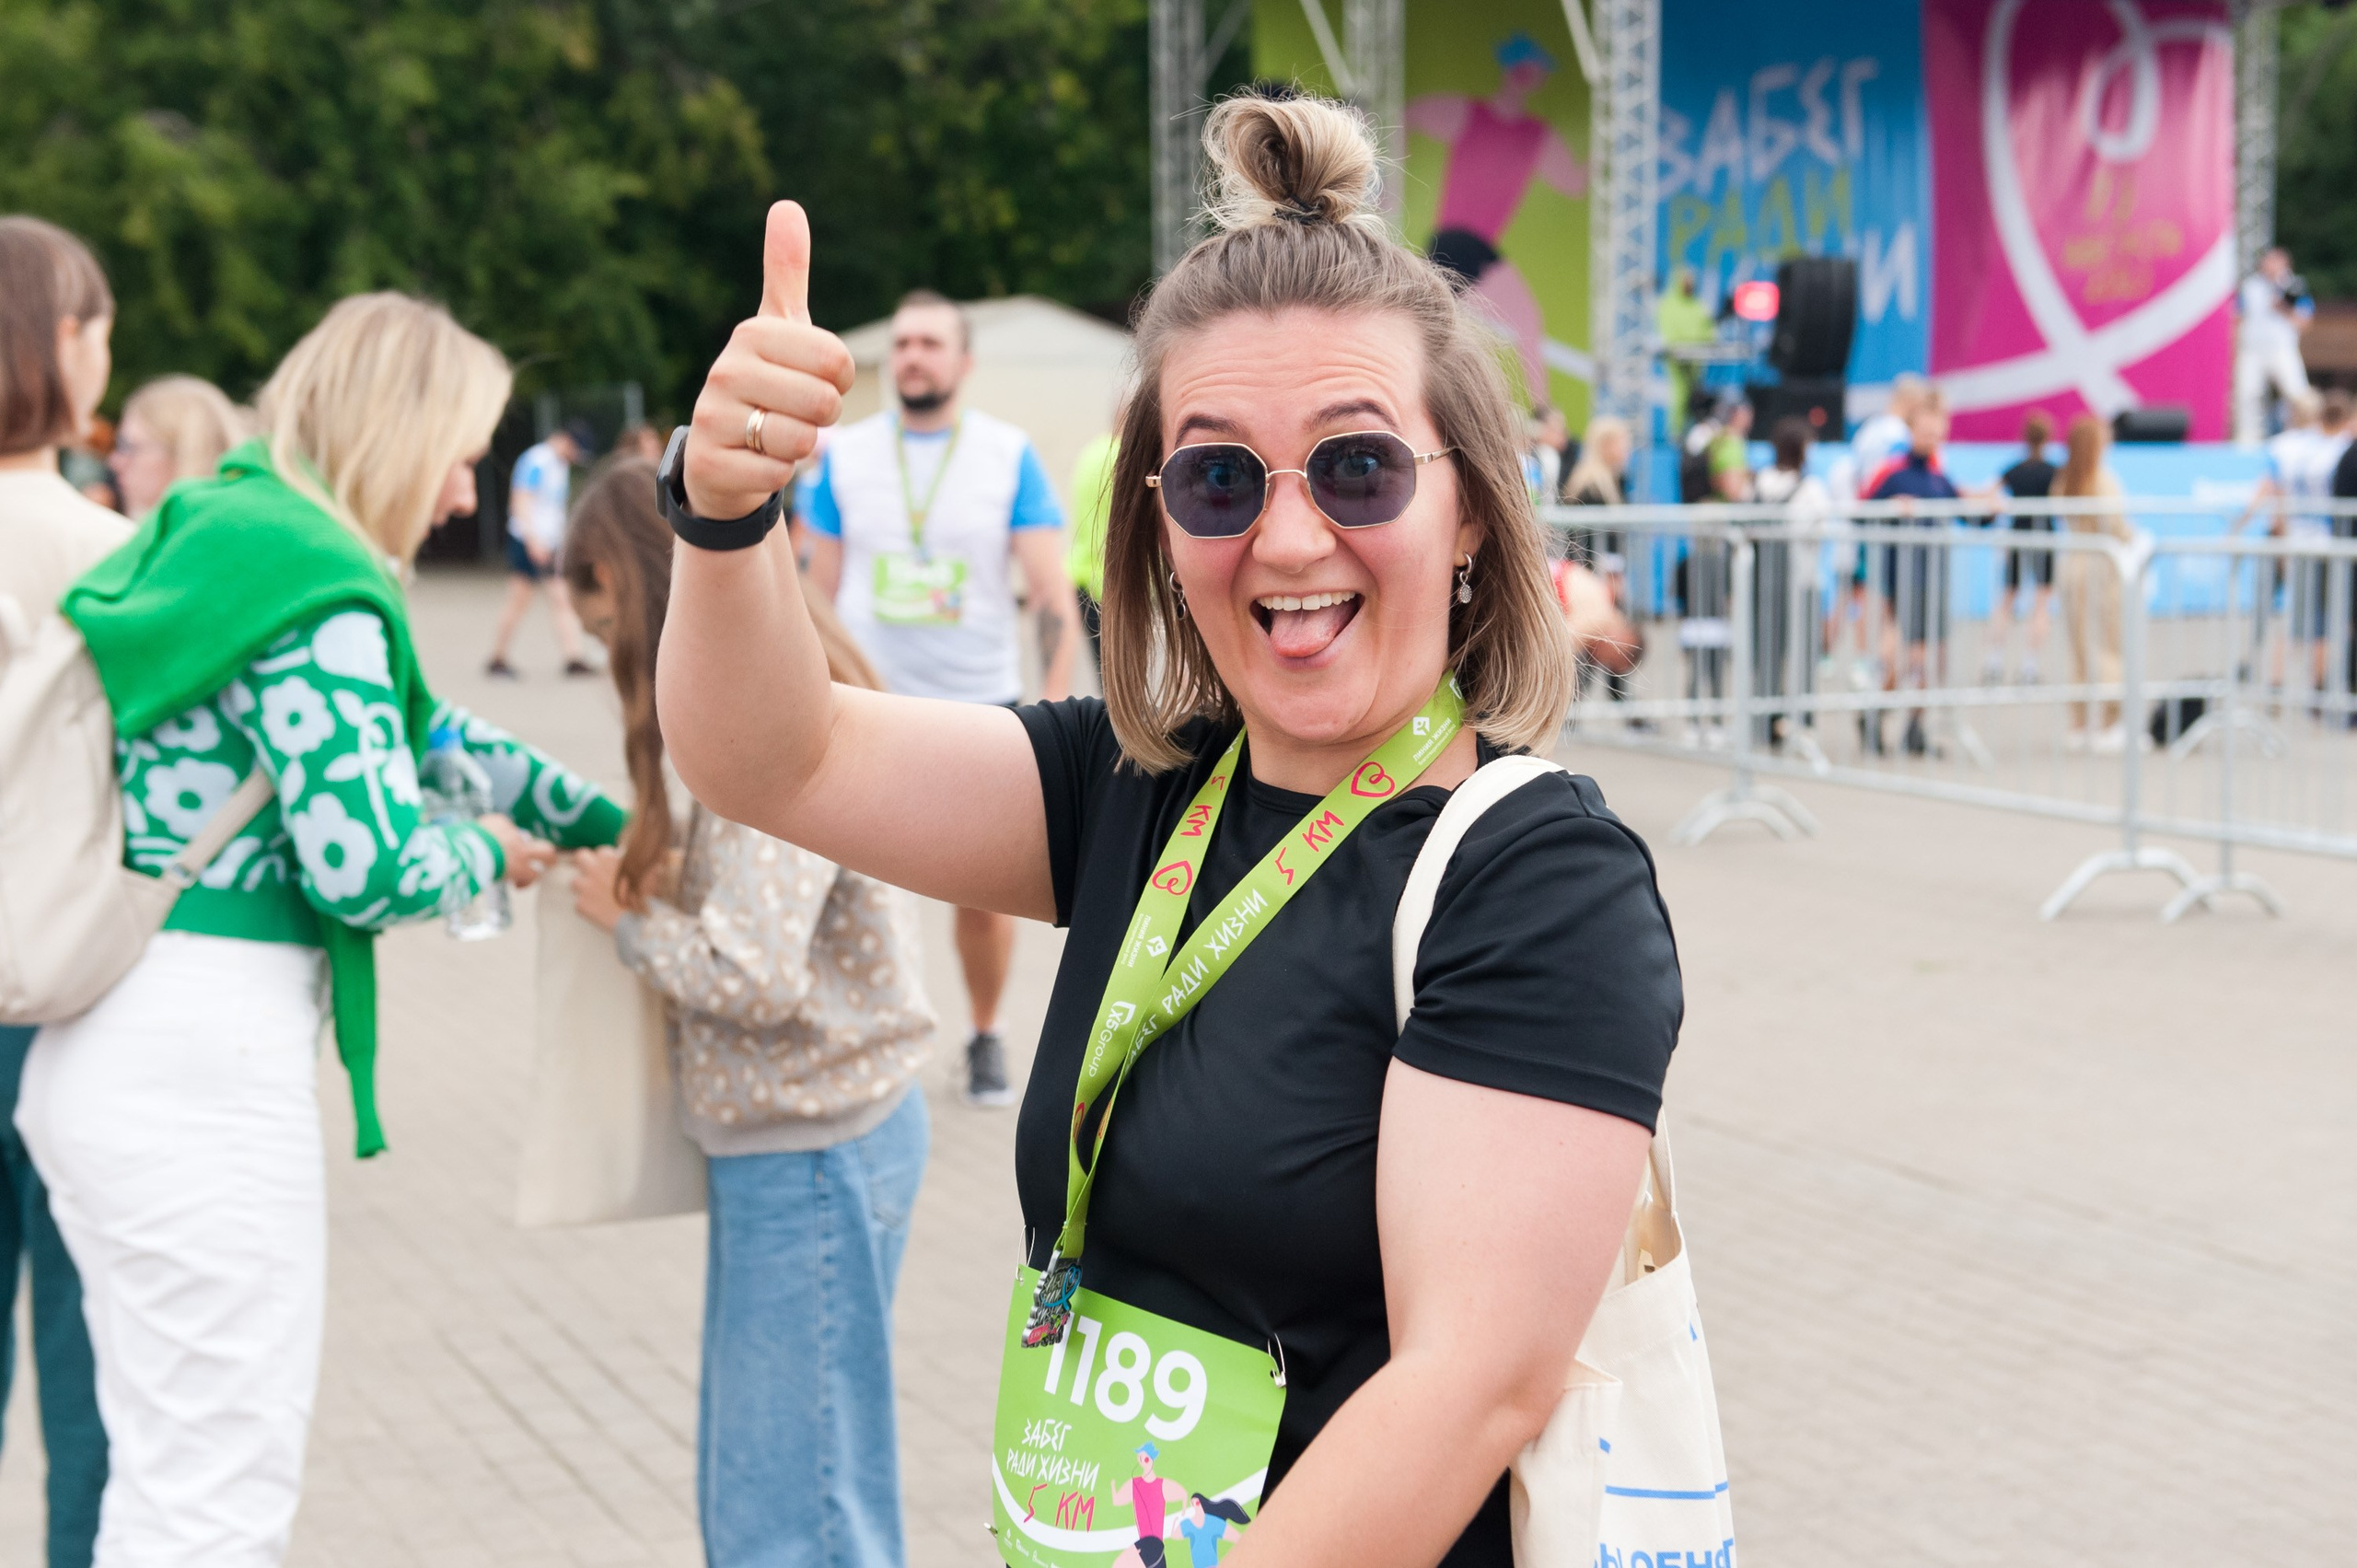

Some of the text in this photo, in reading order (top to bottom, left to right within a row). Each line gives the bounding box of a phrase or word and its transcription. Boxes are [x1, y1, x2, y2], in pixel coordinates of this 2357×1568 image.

[1161, 954, 1210, 1016] РАДИ
[1203, 888, 1269, 961] ЖИЗНИ
[1274, 846, 1295, 886] 5
[1043, 1310, 1208, 1441] 1189
[1021, 1418, 1073, 1452] ЗАБЕГ
[1005, 1447, 1100, 1493] РАДИ ЖИЗНИ
[1023, 1482, 1049, 1524] 5
